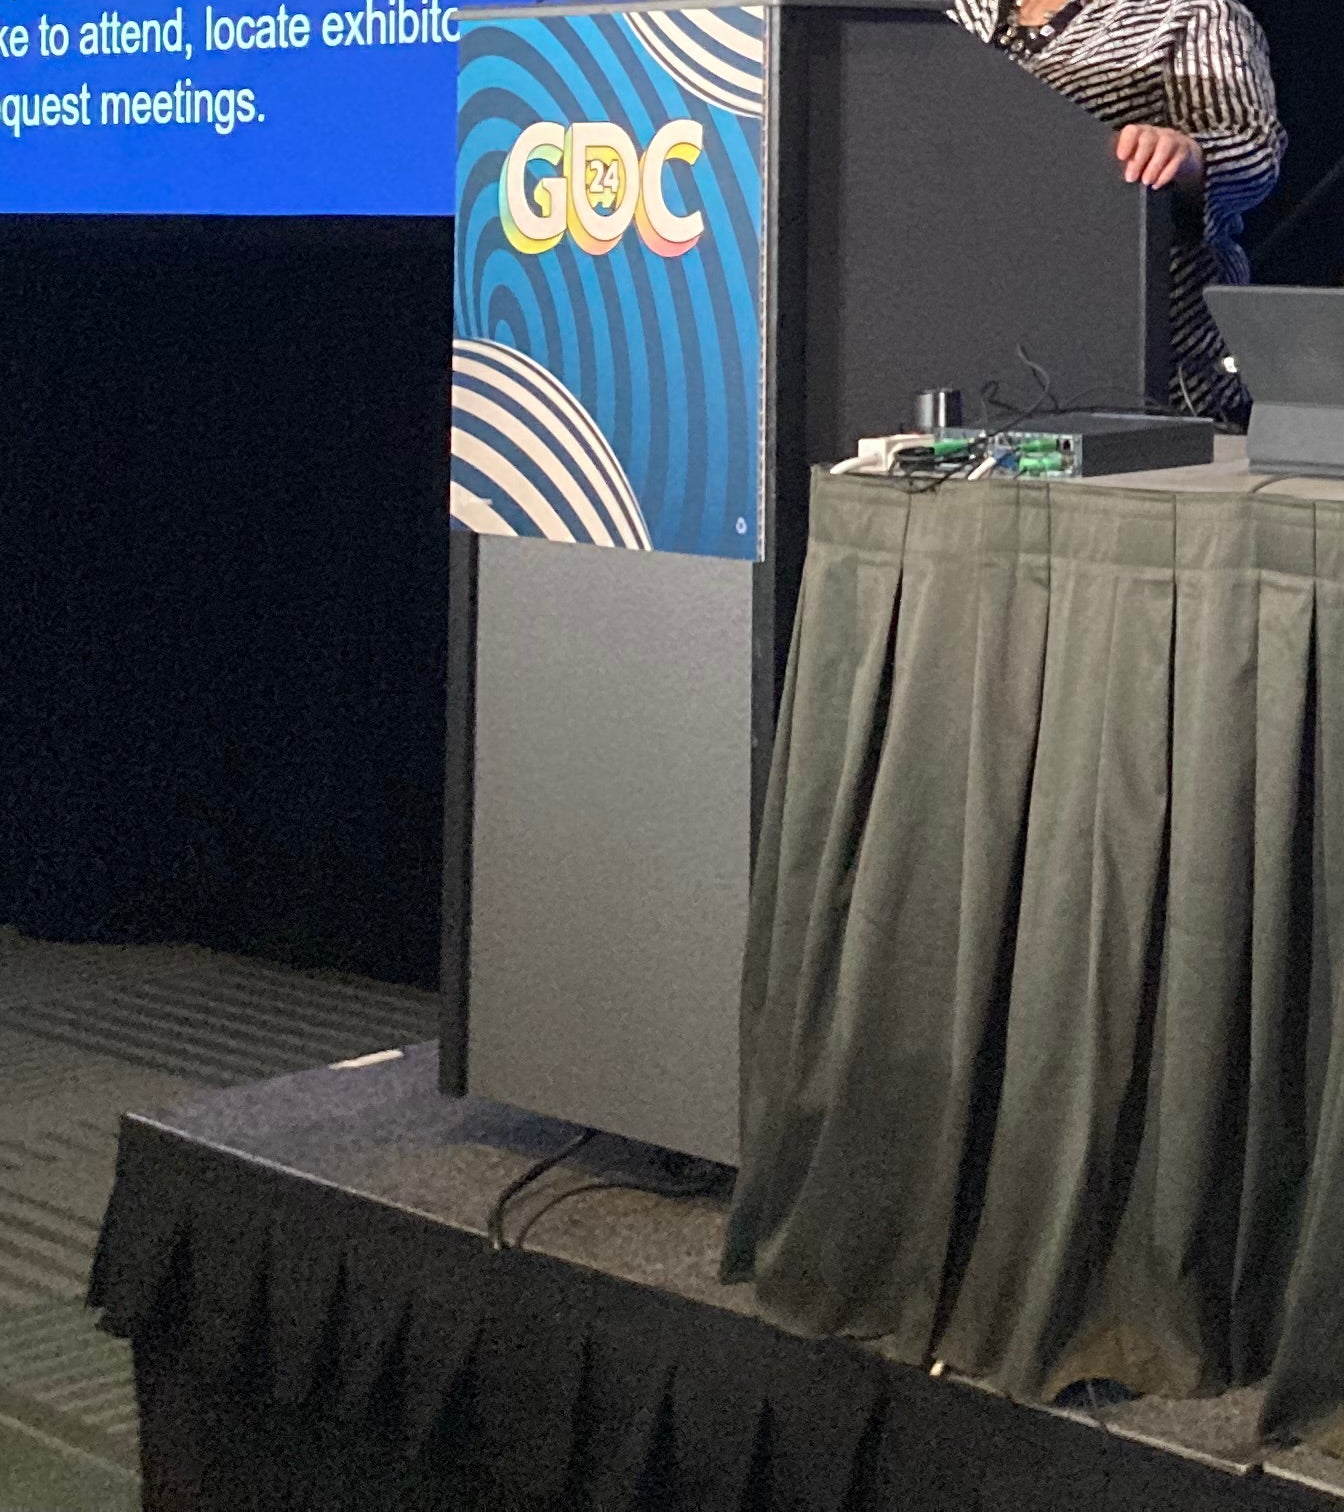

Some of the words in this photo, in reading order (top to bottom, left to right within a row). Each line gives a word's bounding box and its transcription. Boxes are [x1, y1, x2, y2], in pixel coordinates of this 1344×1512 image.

[38, 13, 69, 56] to
[79, 6, 193, 60] attend,
[205, 3, 310, 51] locate
[0, 83, 91, 137] quest
[101, 78, 265, 134] meetings.
[499, 119, 704, 257] GDC
[588, 158, 621, 194] 24
